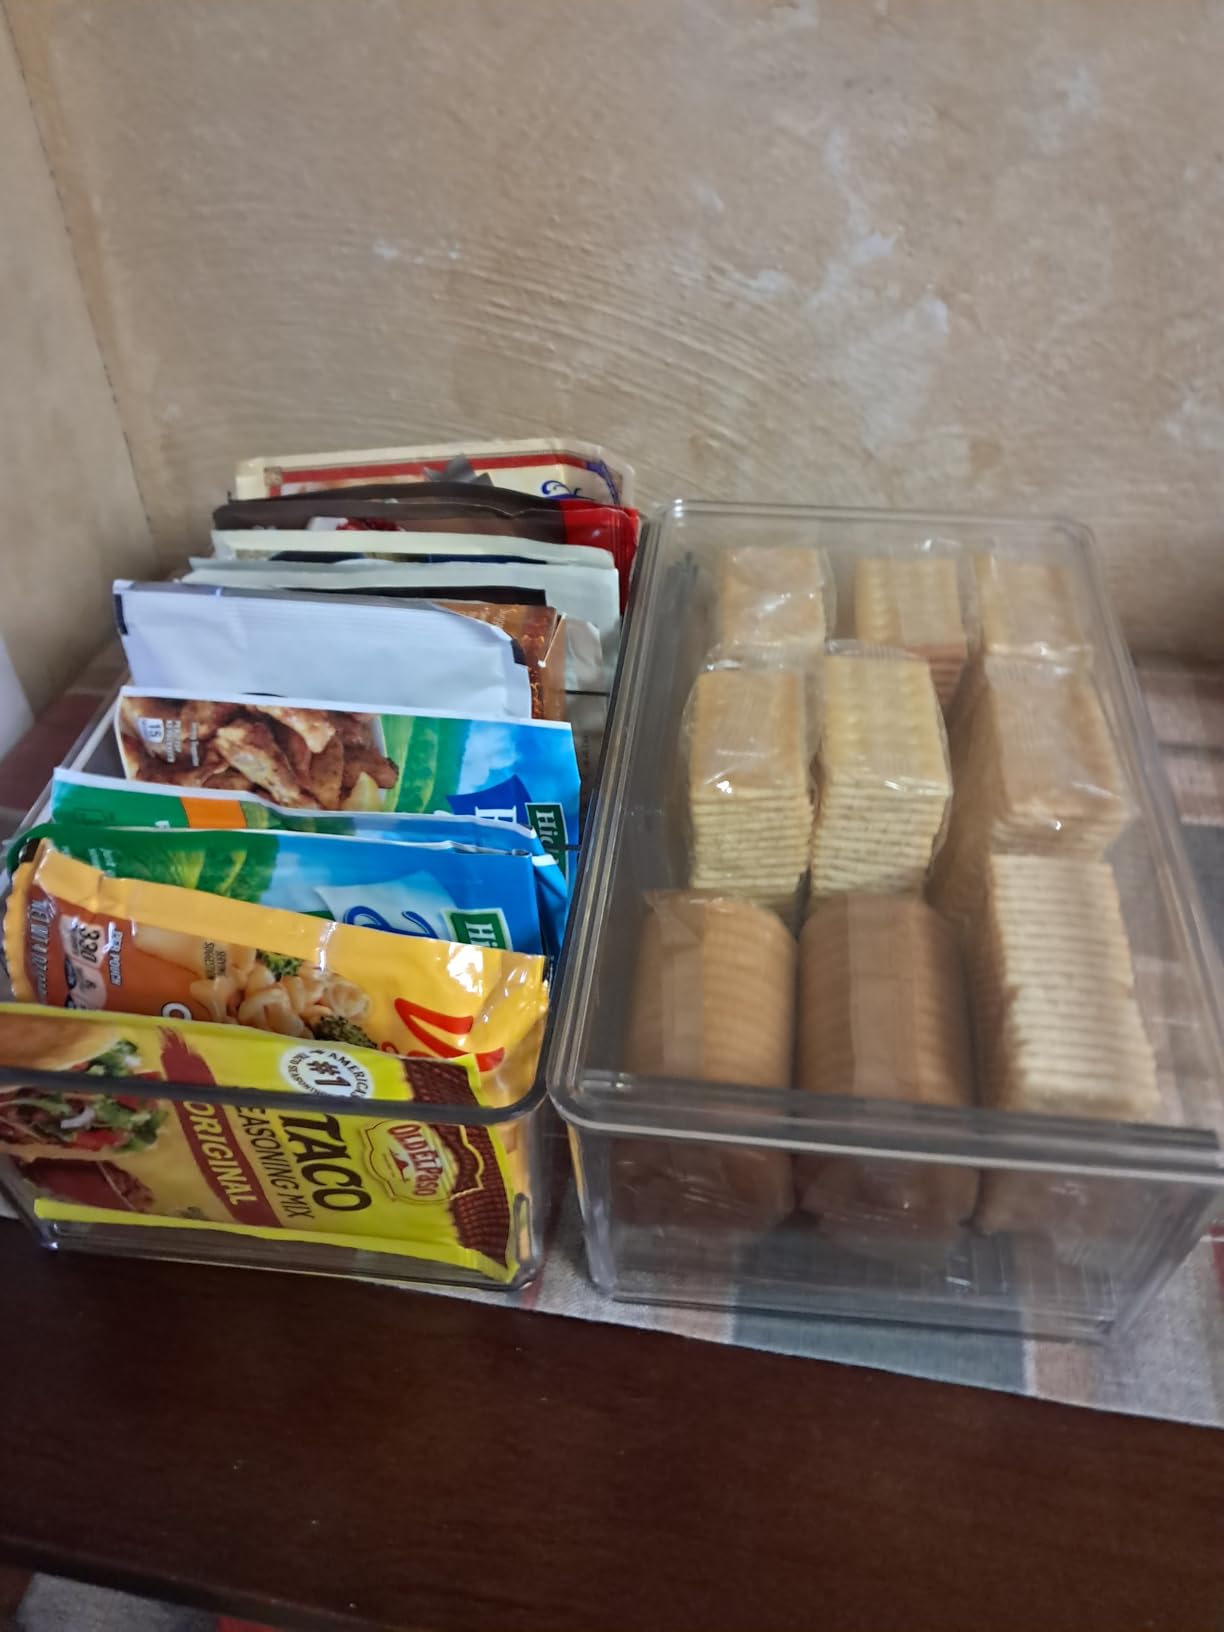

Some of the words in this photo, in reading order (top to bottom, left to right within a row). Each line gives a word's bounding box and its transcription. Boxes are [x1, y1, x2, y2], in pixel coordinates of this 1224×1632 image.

[78, 926, 101, 963] 330
[306, 1060, 352, 1087] #1
[183, 1100, 258, 1206] ORIGINAL
[235, 1104, 300, 1192] EASONING
[277, 1193, 315, 1220] MIX
[278, 1113, 373, 1212] TACO
[387, 1123, 430, 1151] OLD
